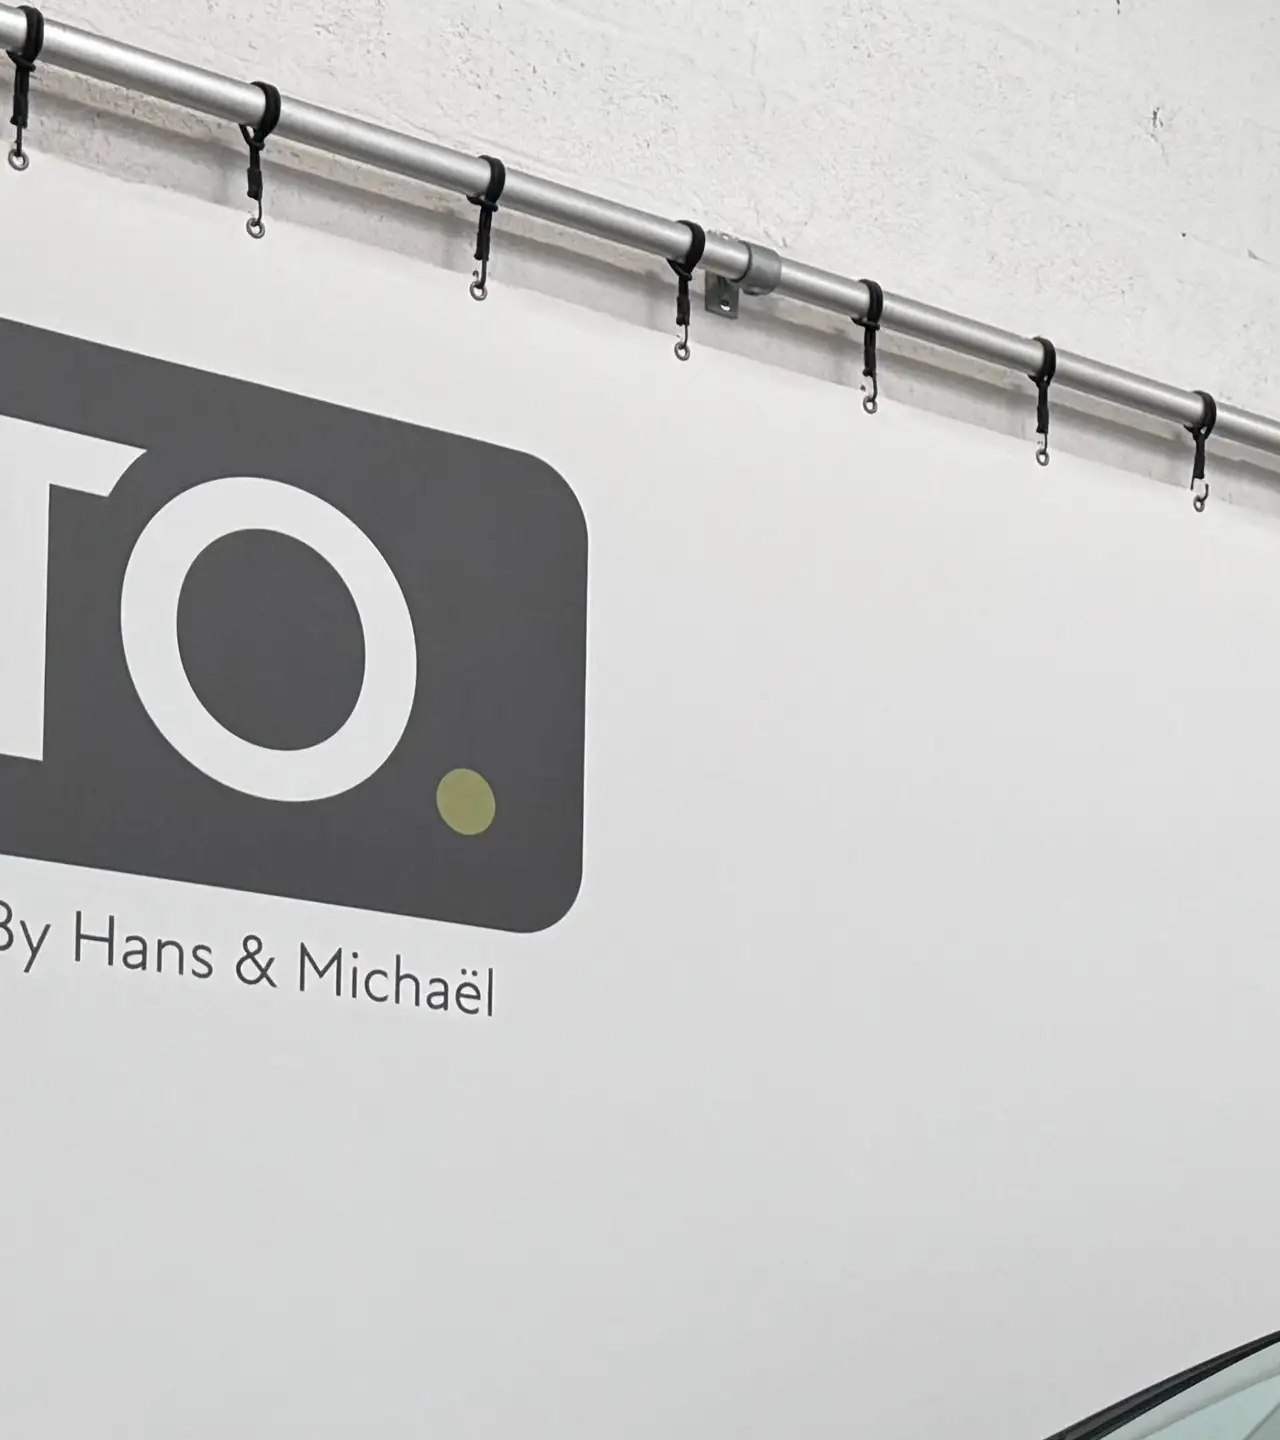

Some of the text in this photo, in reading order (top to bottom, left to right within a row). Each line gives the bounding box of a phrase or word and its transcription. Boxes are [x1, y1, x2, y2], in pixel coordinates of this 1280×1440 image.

[74, 909, 214, 979] Hans
[235, 933, 279, 989] &
[299, 941, 495, 1017] Michaël
